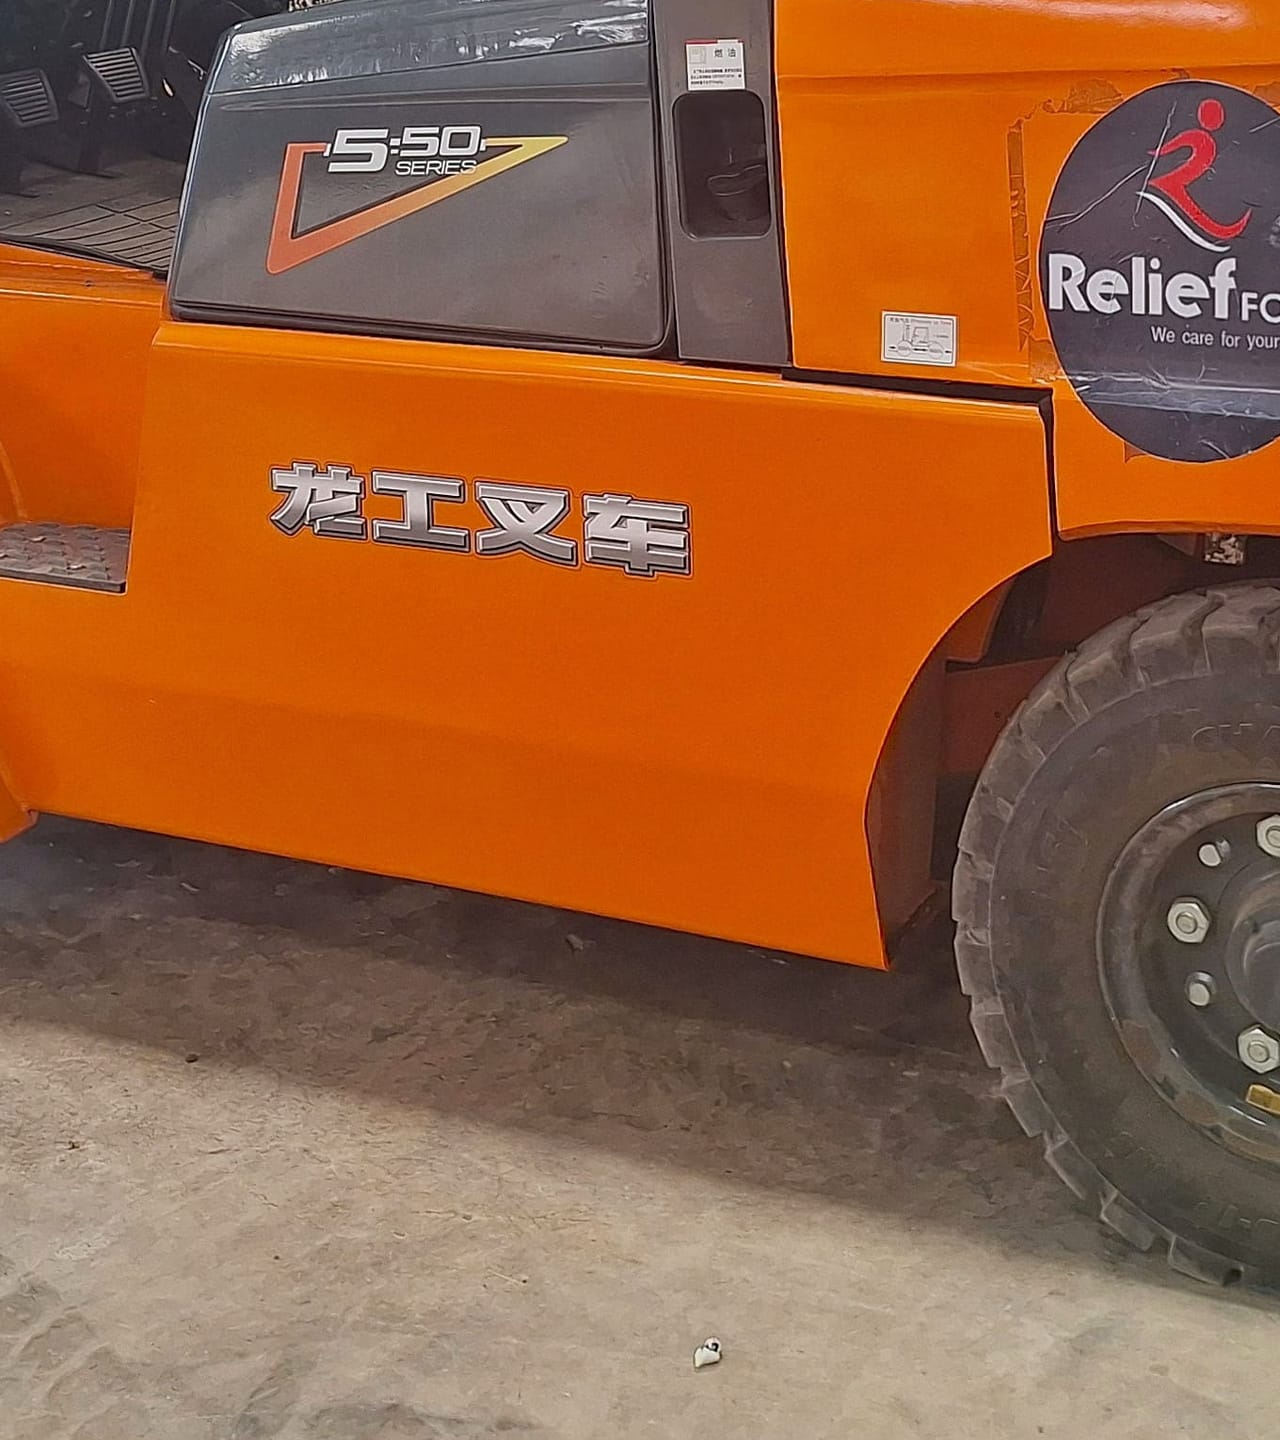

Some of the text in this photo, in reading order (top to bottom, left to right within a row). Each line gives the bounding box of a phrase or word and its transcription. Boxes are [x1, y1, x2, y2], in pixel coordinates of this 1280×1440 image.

[395, 160, 477, 175] SERIES
[1049, 253, 1237, 319] Relief
[1151, 327, 1175, 345] We
[1182, 332, 1213, 348] care
[1221, 332, 1241, 349] for
[1246, 335, 1280, 352] your
[270, 462, 692, 578] 龙工叉车
